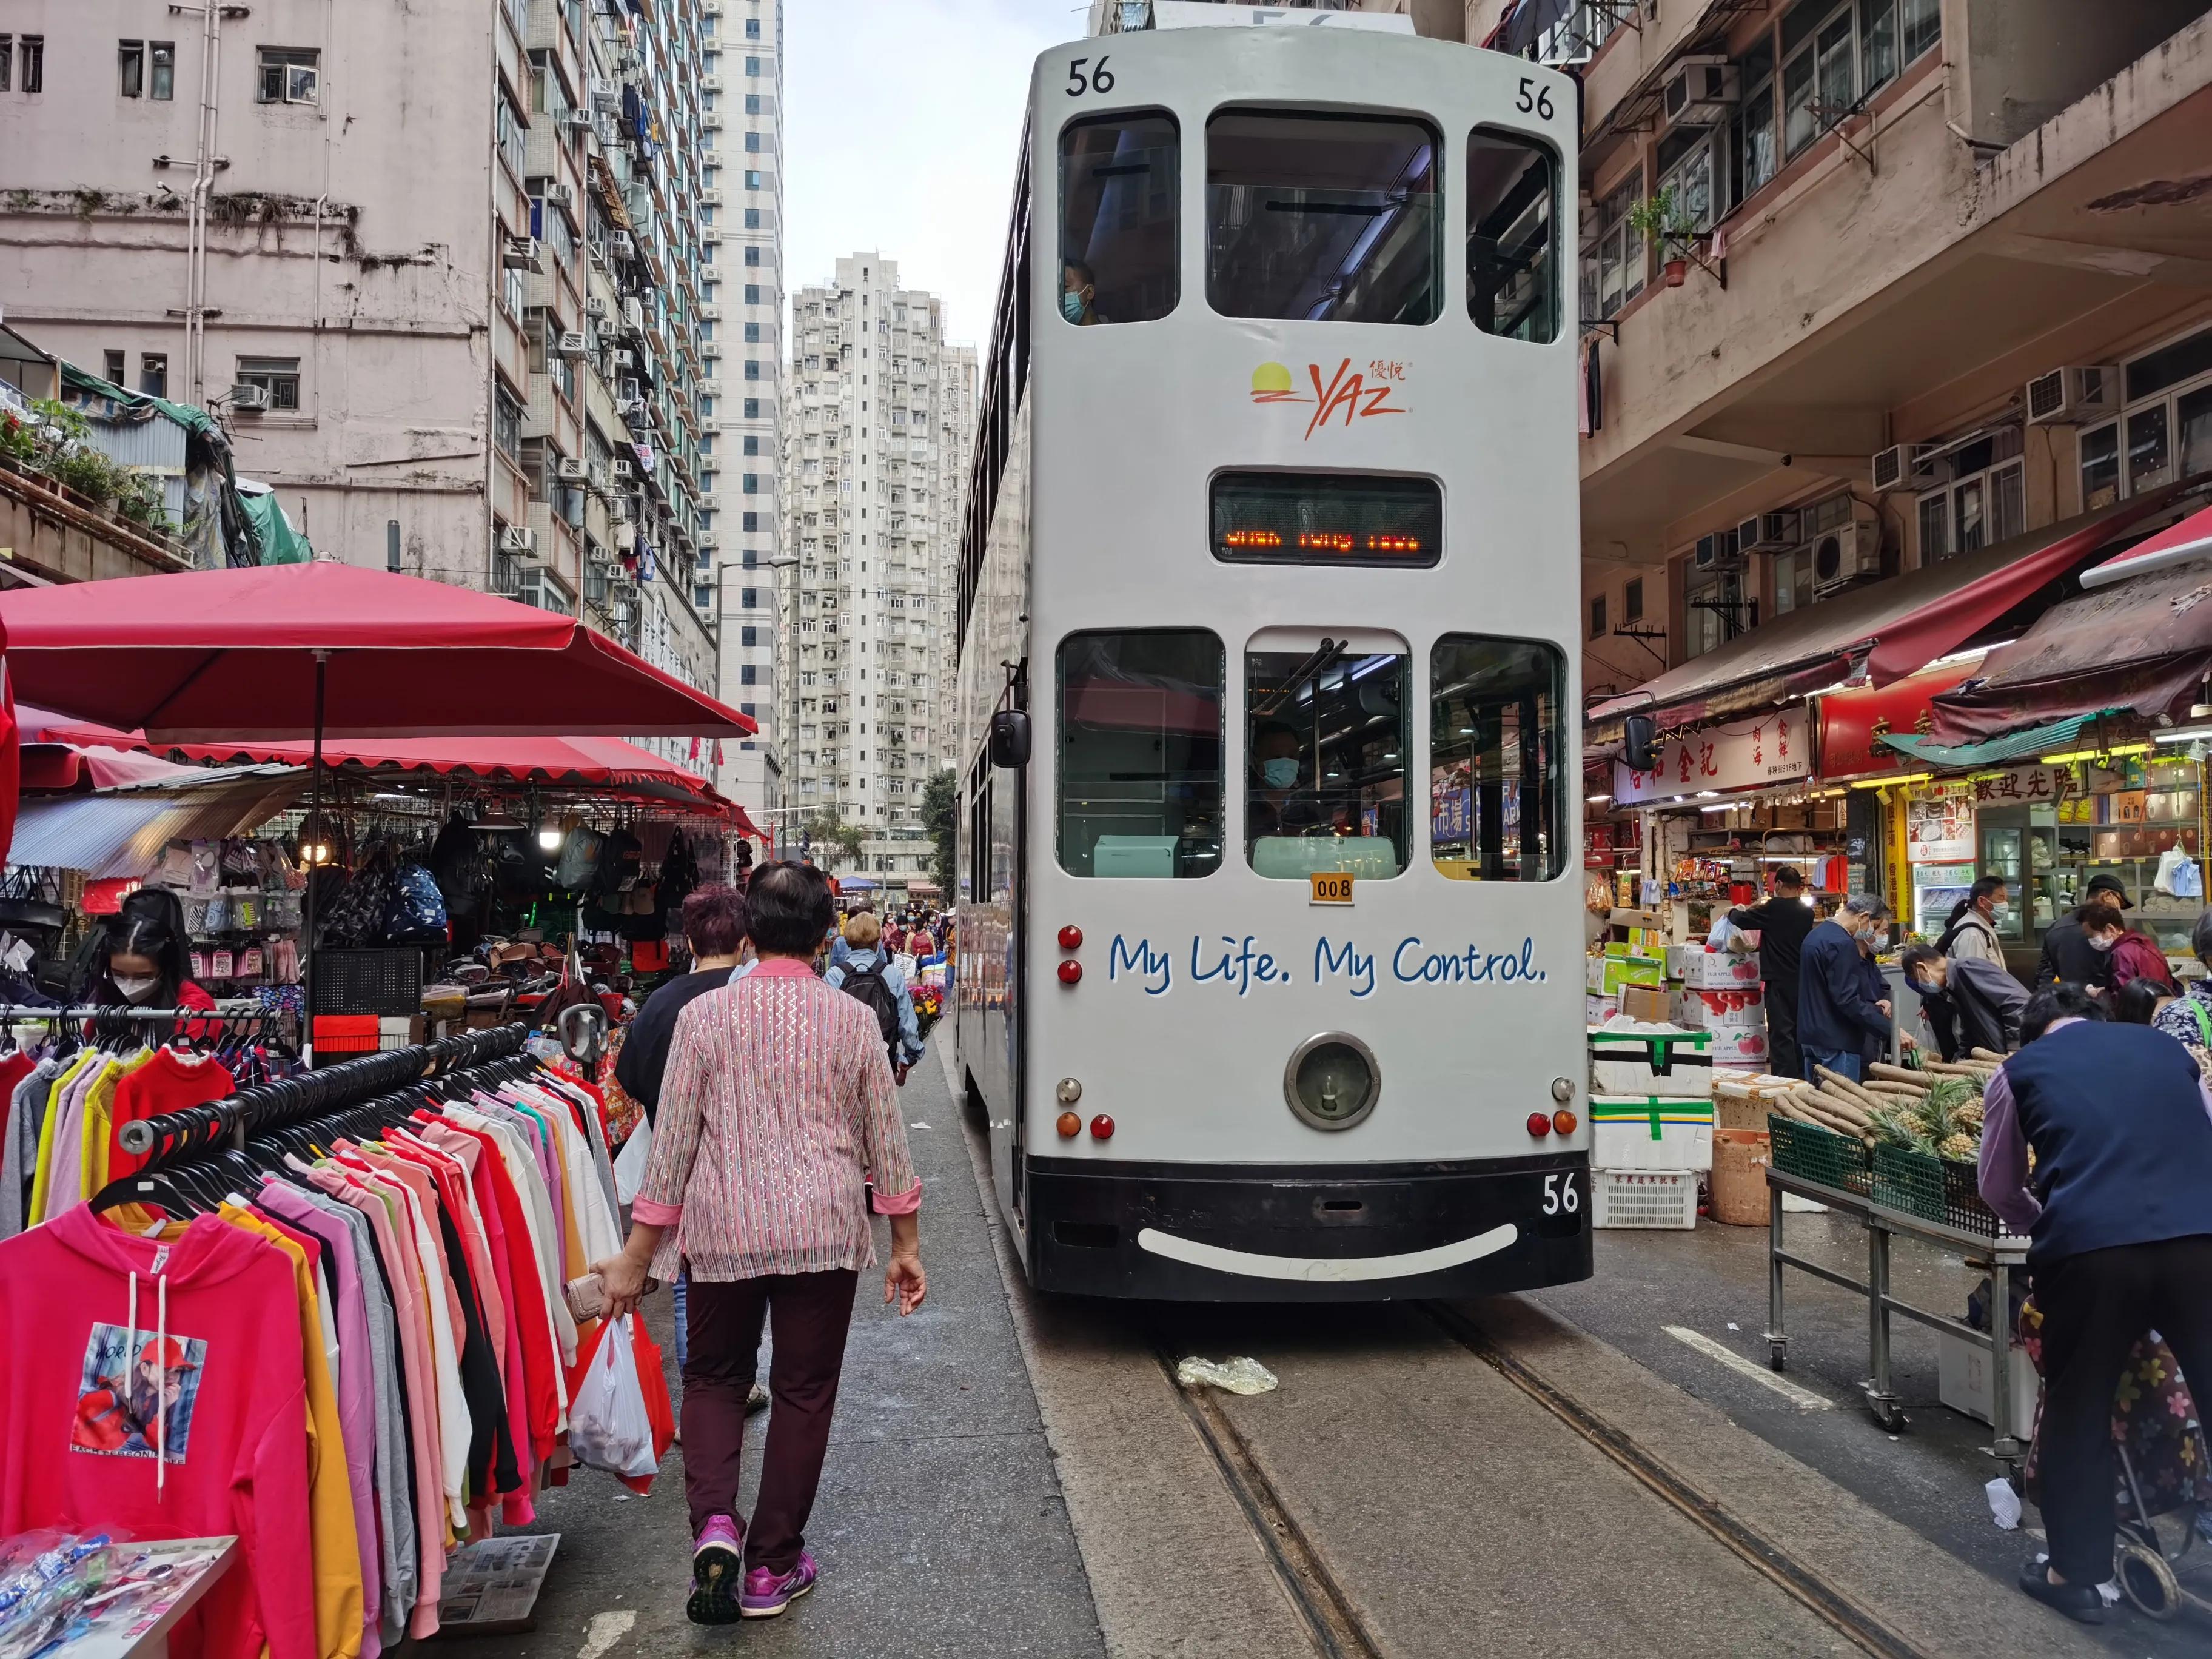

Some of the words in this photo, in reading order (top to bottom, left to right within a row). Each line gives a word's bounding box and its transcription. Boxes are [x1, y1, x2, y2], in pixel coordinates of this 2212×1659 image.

[1065, 55, 1115, 97] 56
[1516, 78, 1554, 121] 56
[1304, 358, 1406, 441] YAZ
[1975, 768, 2077, 803] 歡迎光臨
[1317, 880, 1351, 897] 008
[1110, 935, 1173, 995] My
[1192, 937, 1290, 996] Life.
[1316, 937, 1376, 997] My
[1394, 937, 1546, 982] Control.
[1542, 1173, 1579, 1215] 56
